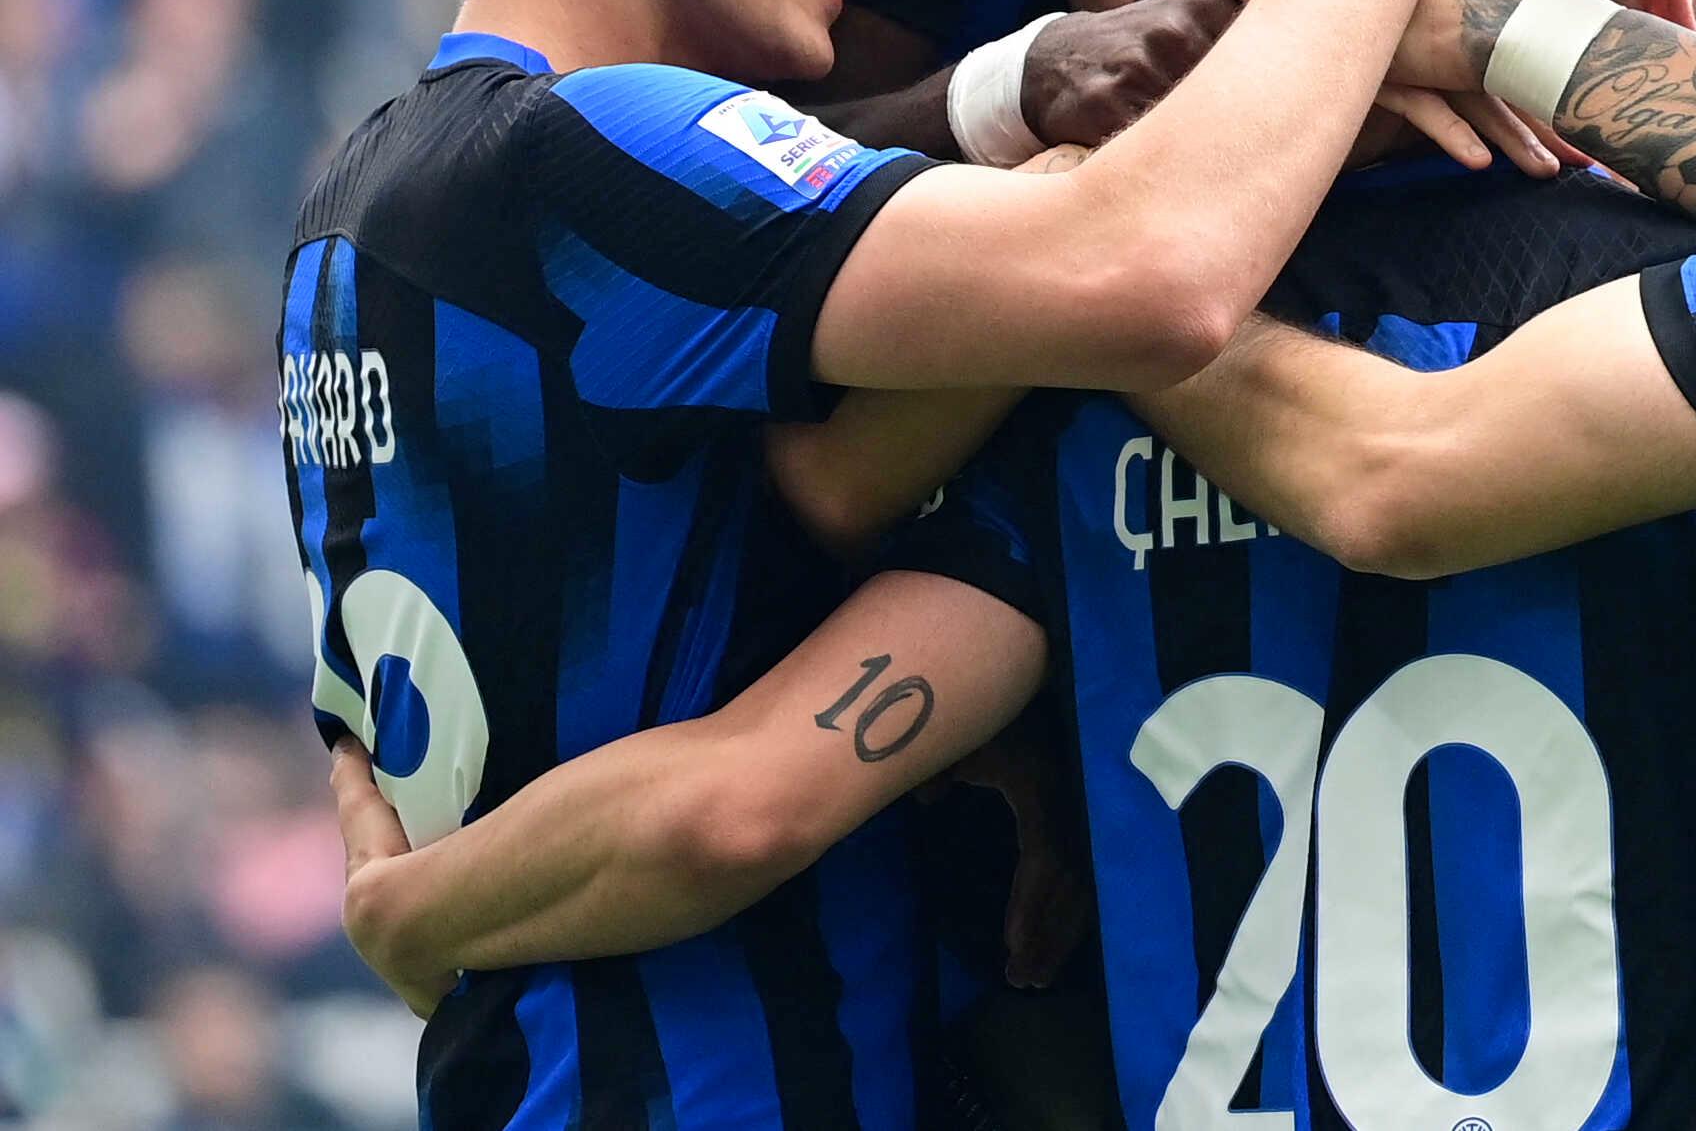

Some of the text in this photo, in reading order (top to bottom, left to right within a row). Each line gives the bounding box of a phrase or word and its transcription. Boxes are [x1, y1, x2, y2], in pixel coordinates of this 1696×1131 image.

[781, 134, 822, 168] SERIE
[1573, 63, 1696, 143] Olga
[277, 350, 397, 469] AVARD
[1114, 436, 1281, 571] ÇAL
[814, 653, 934, 763] 10
[1129, 653, 1619, 1131] 20
